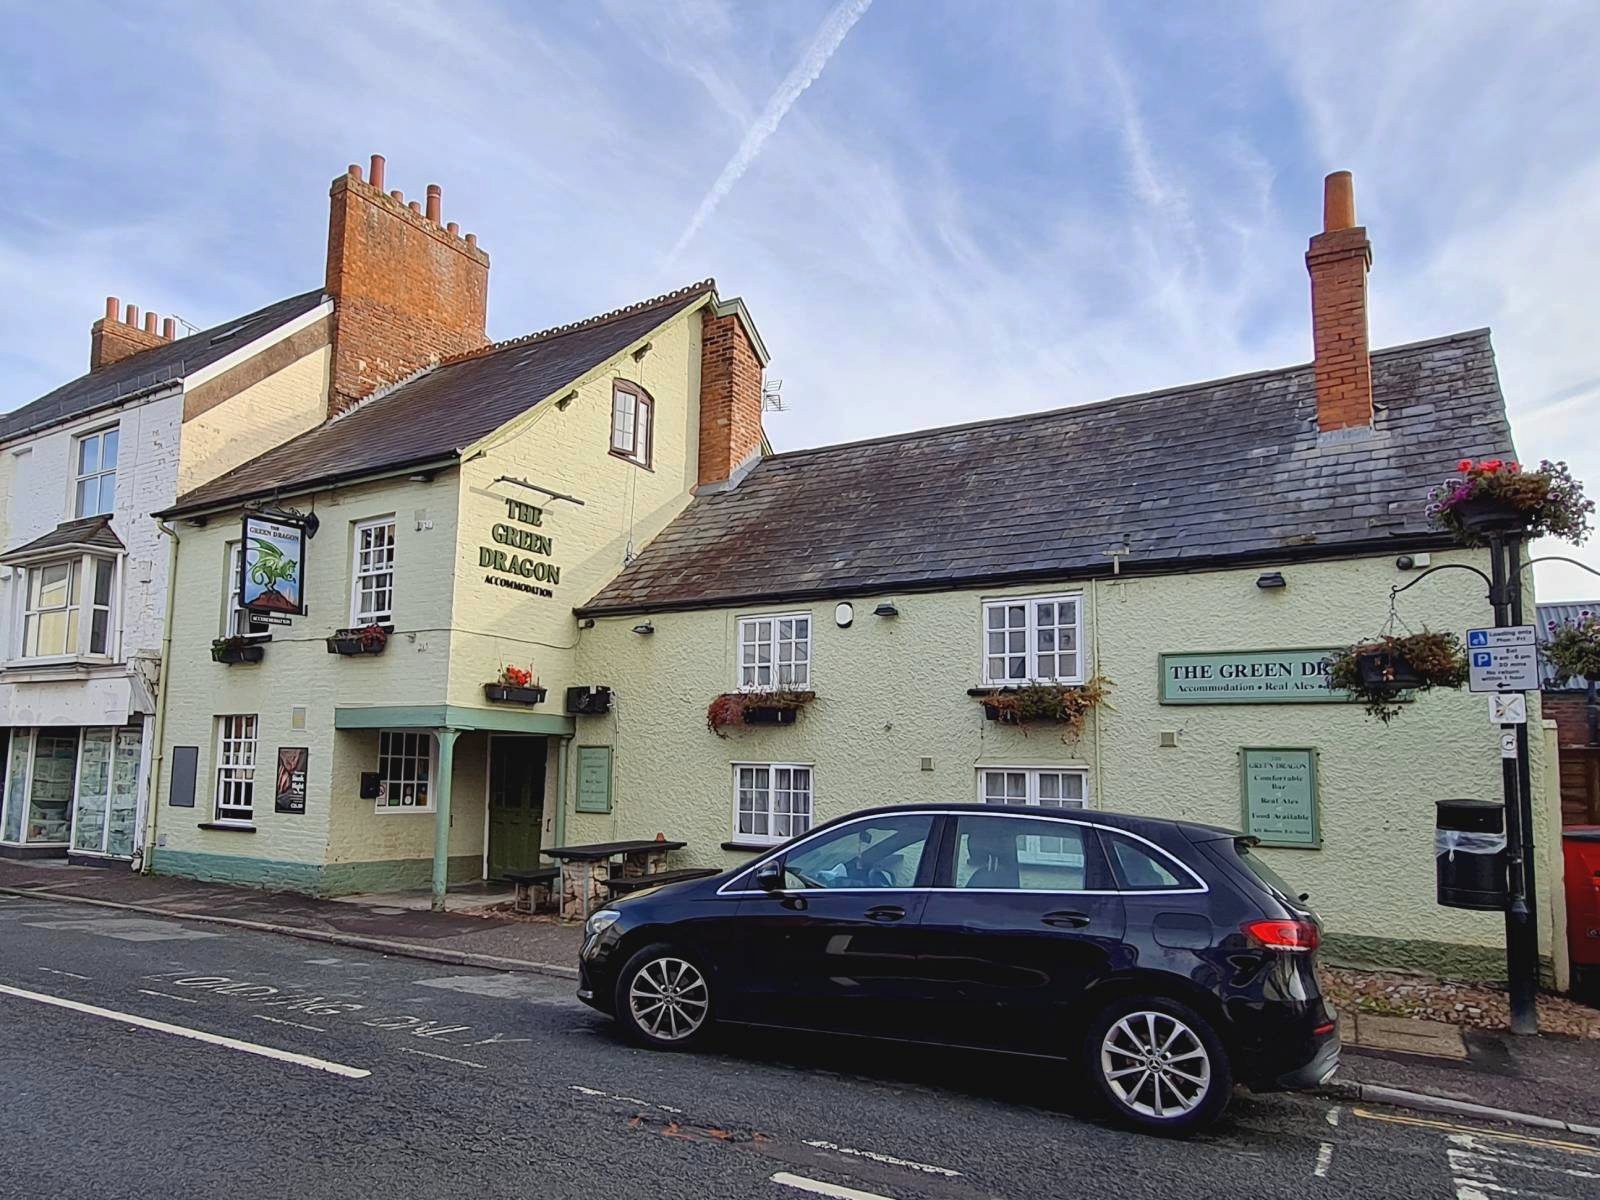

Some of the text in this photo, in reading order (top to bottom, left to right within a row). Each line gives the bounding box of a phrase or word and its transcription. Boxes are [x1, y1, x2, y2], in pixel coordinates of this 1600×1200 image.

[505, 498, 543, 527] THE
[249, 526, 299, 541] GREEN DRAGON
[492, 523, 553, 556] GREEN
[479, 546, 560, 585] DRAGON
[484, 574, 553, 598] ACCOMMODATION
[1171, 664, 1213, 680] THE
[1219, 662, 1294, 679] GREEN
[1177, 682, 1255, 693] Accommodation
[1265, 681, 1289, 691] Real
[1293, 680, 1314, 690] Ales
